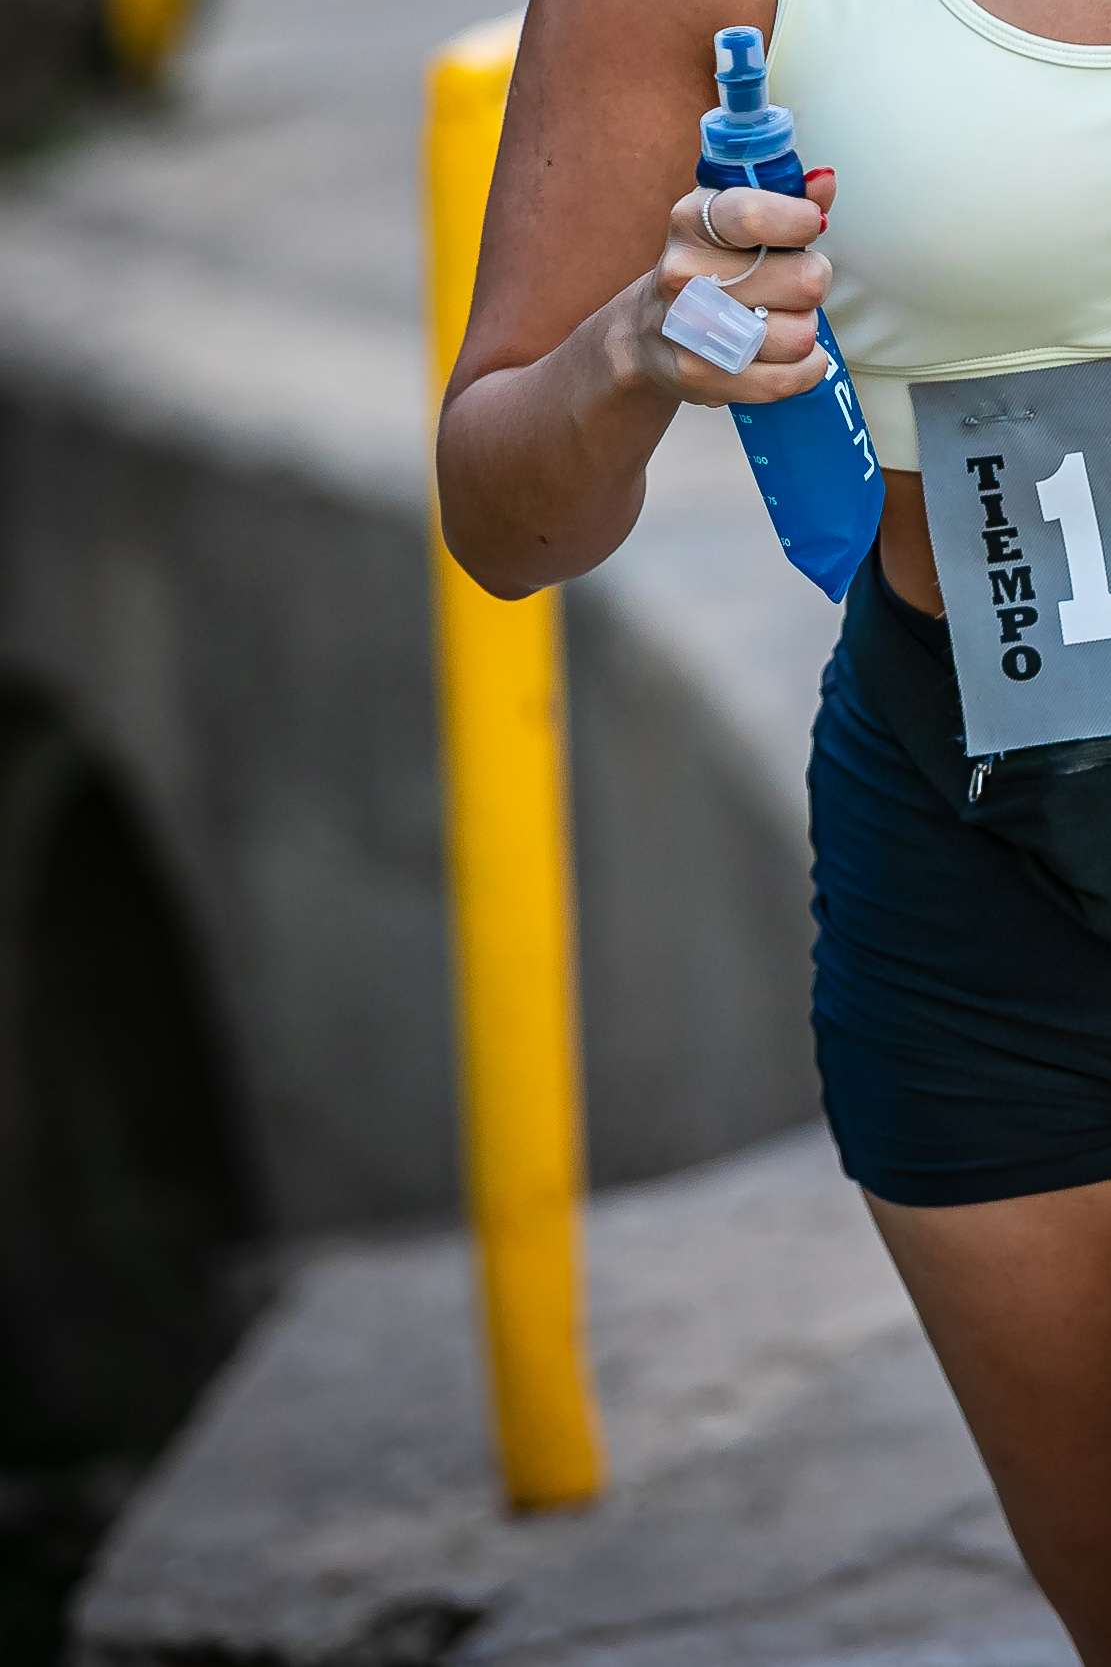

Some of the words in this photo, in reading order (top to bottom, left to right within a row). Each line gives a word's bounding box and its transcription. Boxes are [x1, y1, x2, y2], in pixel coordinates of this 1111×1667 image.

[738, 413, 753, 424] 125
[752, 455, 769, 465] 100
[965, 454, 1044, 682] TIEMPO
